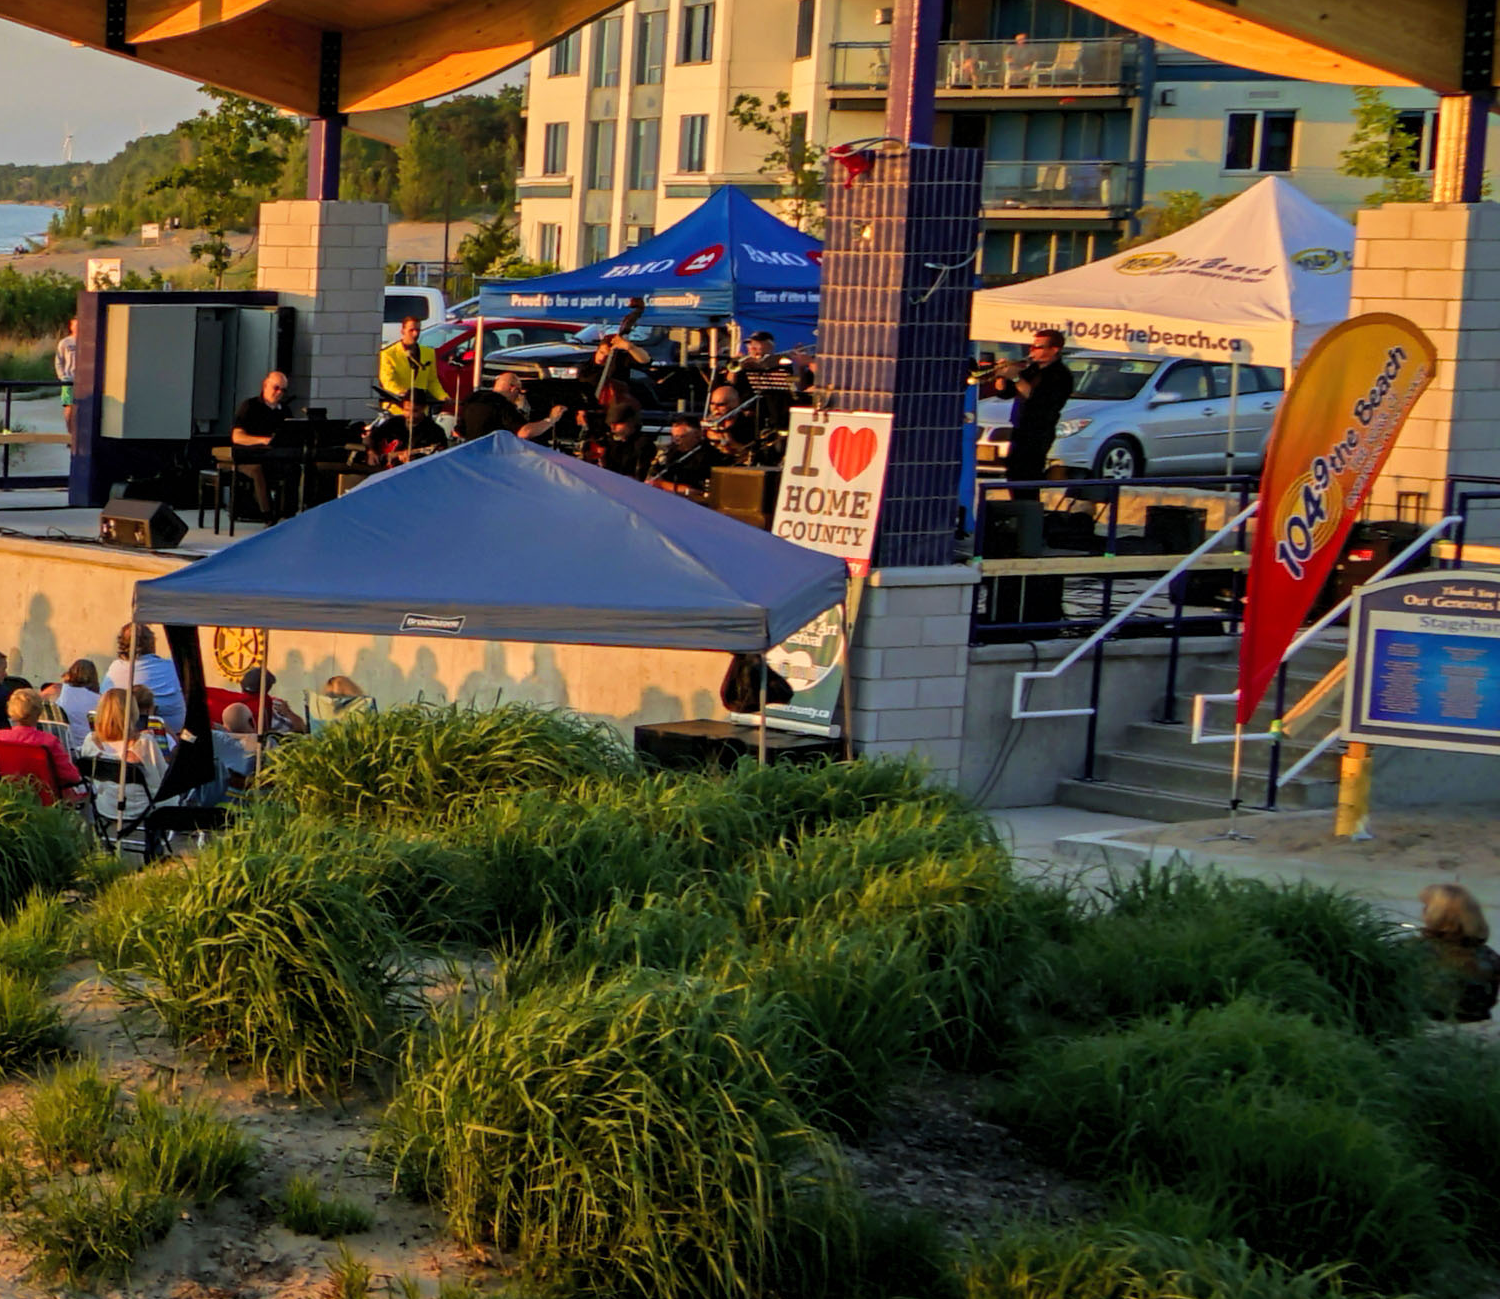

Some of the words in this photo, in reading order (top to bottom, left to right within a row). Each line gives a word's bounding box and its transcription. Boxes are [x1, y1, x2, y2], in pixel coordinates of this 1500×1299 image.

[600, 258, 675, 279] BMO
[740, 243, 809, 268] BMO
[510, 293, 543, 307] Proud
[543, 294, 553, 307] to
[555, 294, 569, 307] be
[580, 294, 603, 309] part
[1329, 428, 1361, 473] the
[1353, 346, 1408, 426] Beach
[790, 424, 826, 478] I
[782, 485, 873, 520] HOME
[777, 519, 867, 547] COUNTY
[1403, 594, 1430, 607] Our
[1432, 596, 1494, 611] Generous
